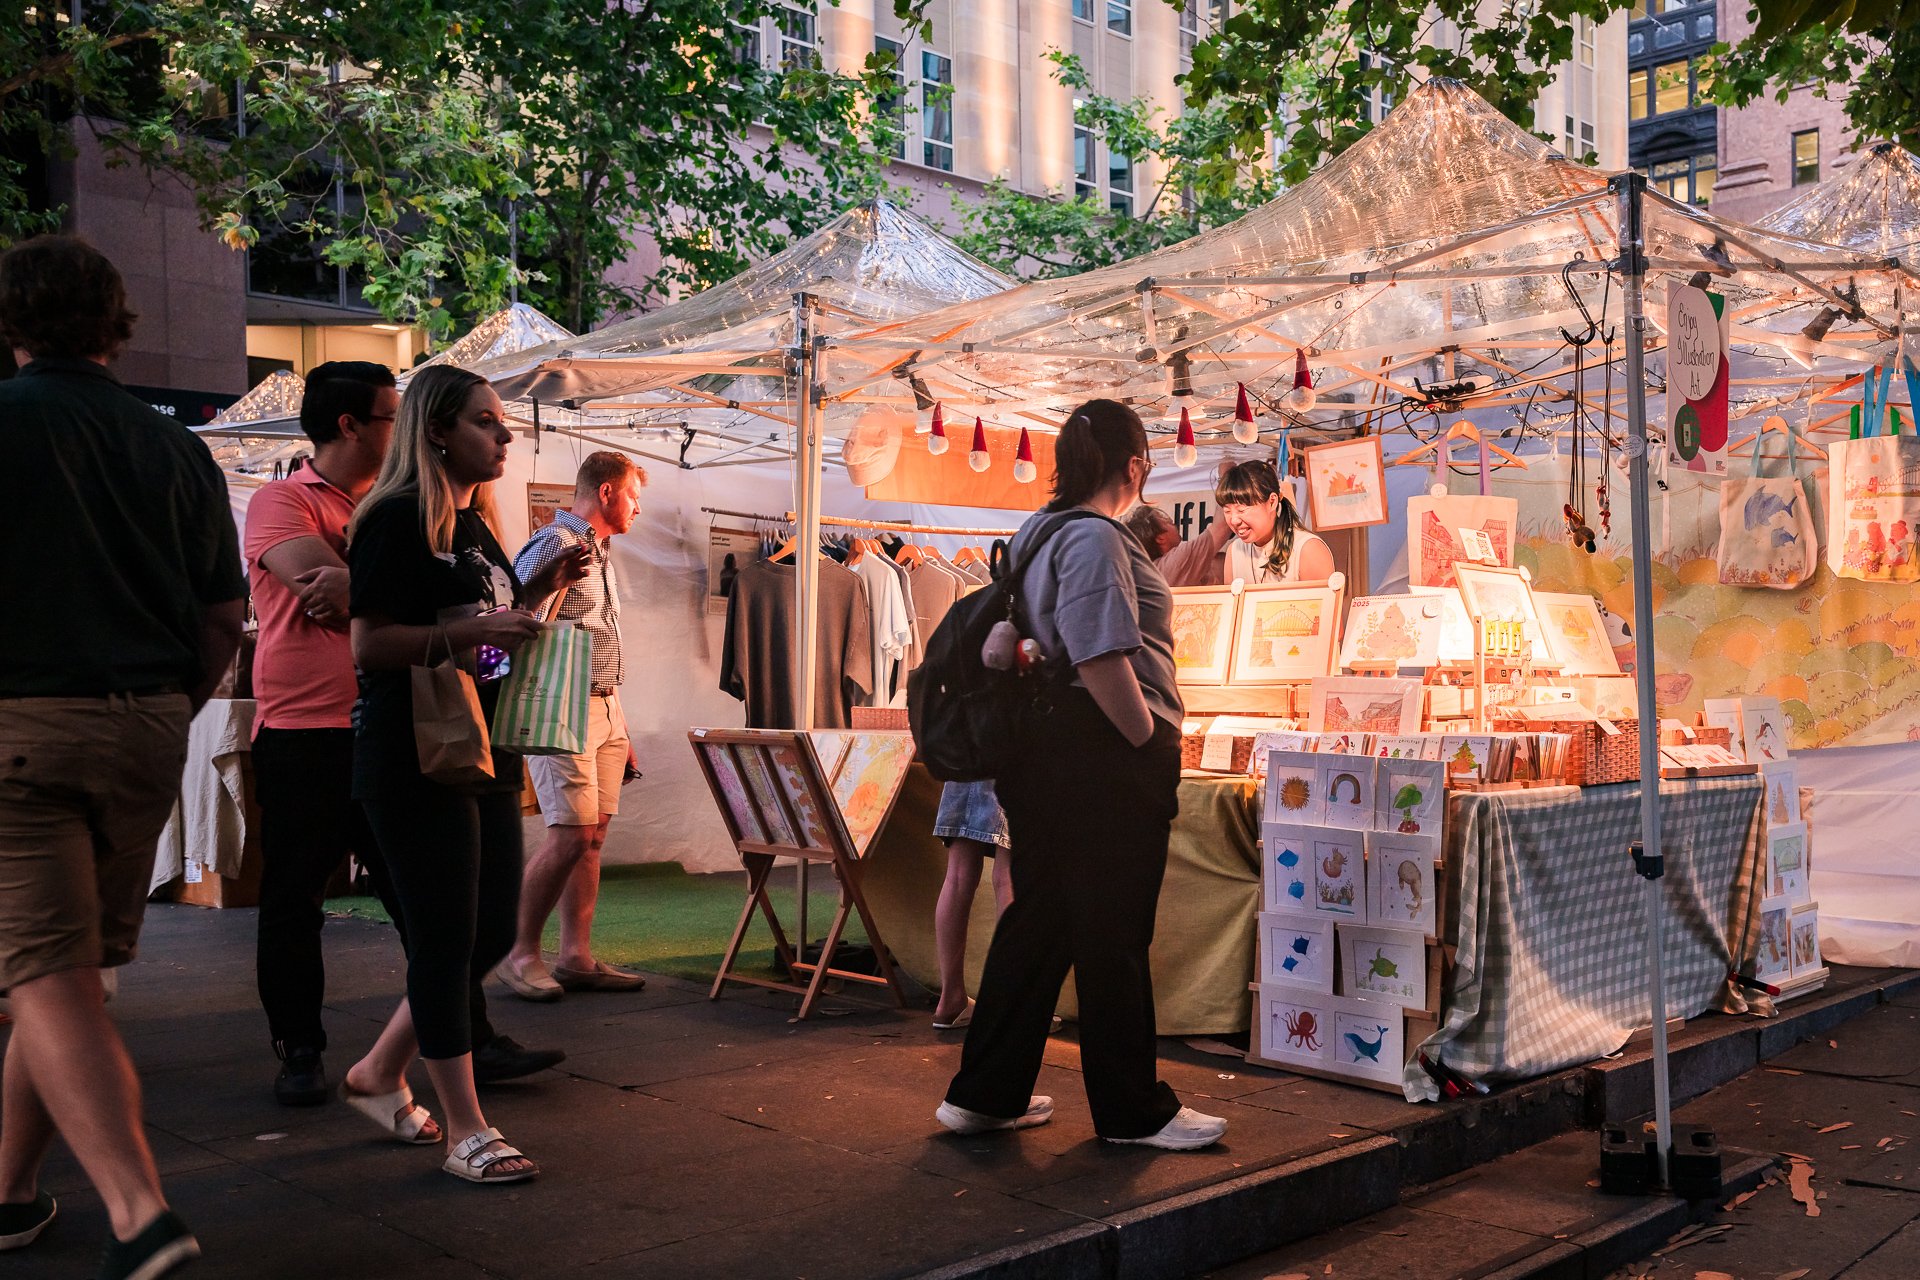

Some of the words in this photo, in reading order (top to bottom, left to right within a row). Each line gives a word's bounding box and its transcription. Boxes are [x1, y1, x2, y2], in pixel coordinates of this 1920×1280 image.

[1677, 302, 1699, 340] Enjoy
[1676, 335, 1716, 374] Illustration
[1689, 369, 1702, 397] Art
